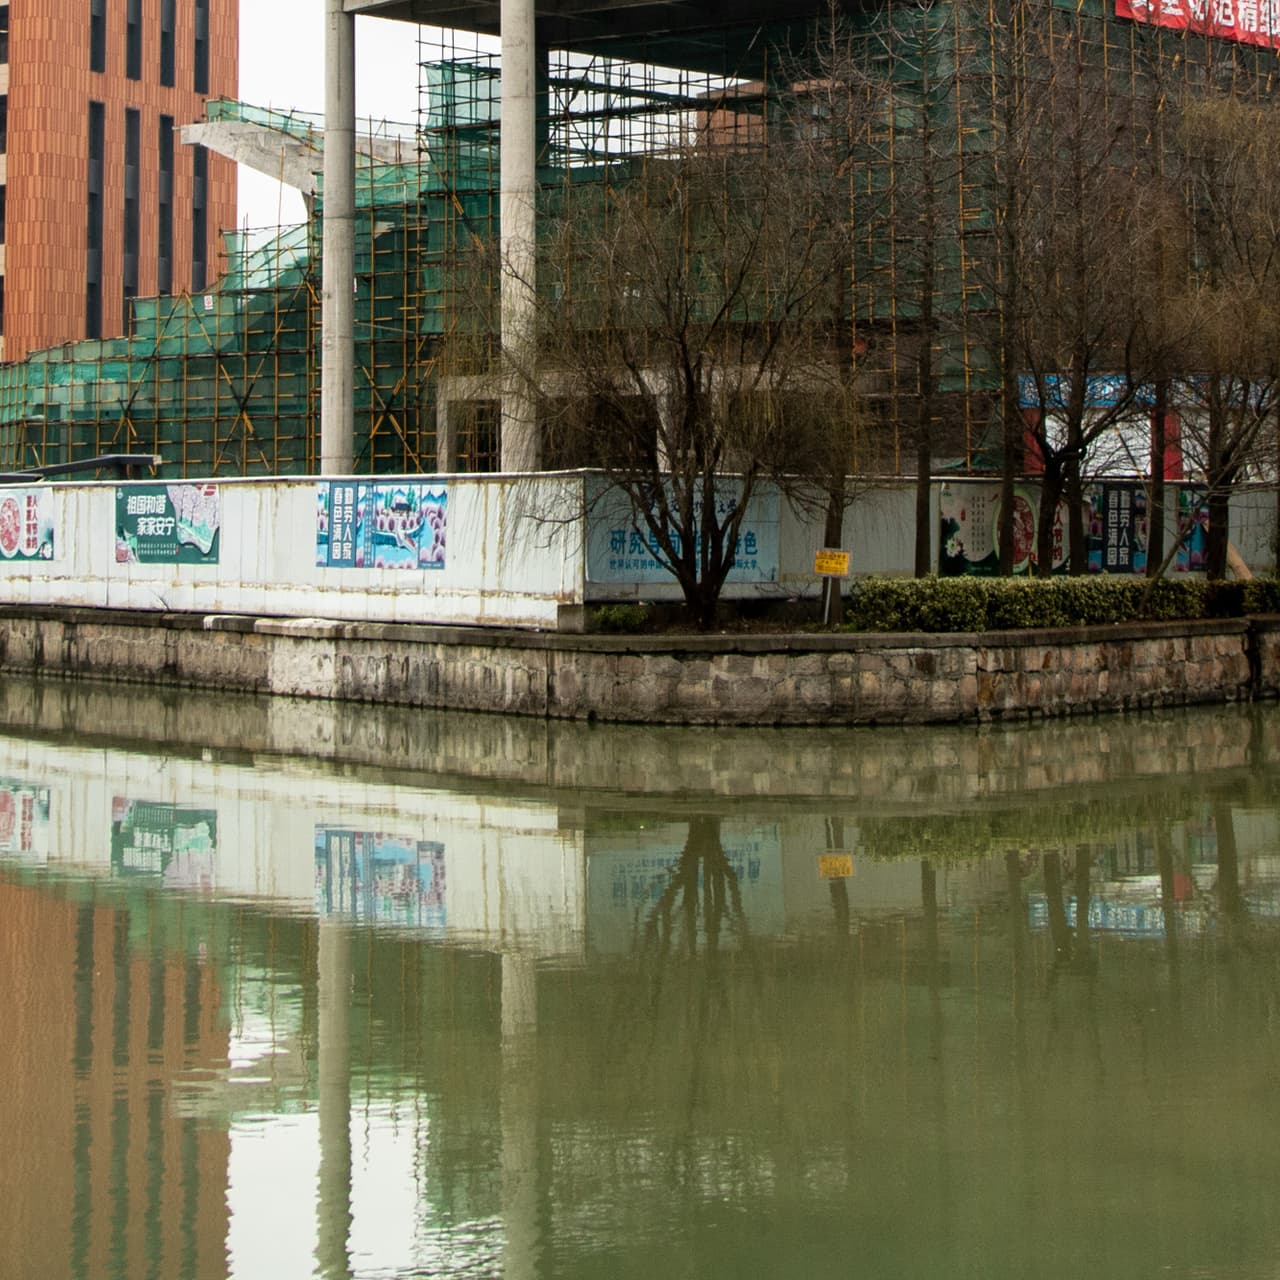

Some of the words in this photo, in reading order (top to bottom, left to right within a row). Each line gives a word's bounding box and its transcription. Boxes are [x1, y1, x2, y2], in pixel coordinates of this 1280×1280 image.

[127, 494, 167, 515] 祖国和谐
[137, 516, 175, 536] 家家安宁
[332, 487, 343, 560] 春色满园
[342, 487, 354, 560] 勤劳人家
[1107, 489, 1119, 566] 春色满园
[1119, 489, 1131, 565] 勤劳人家
